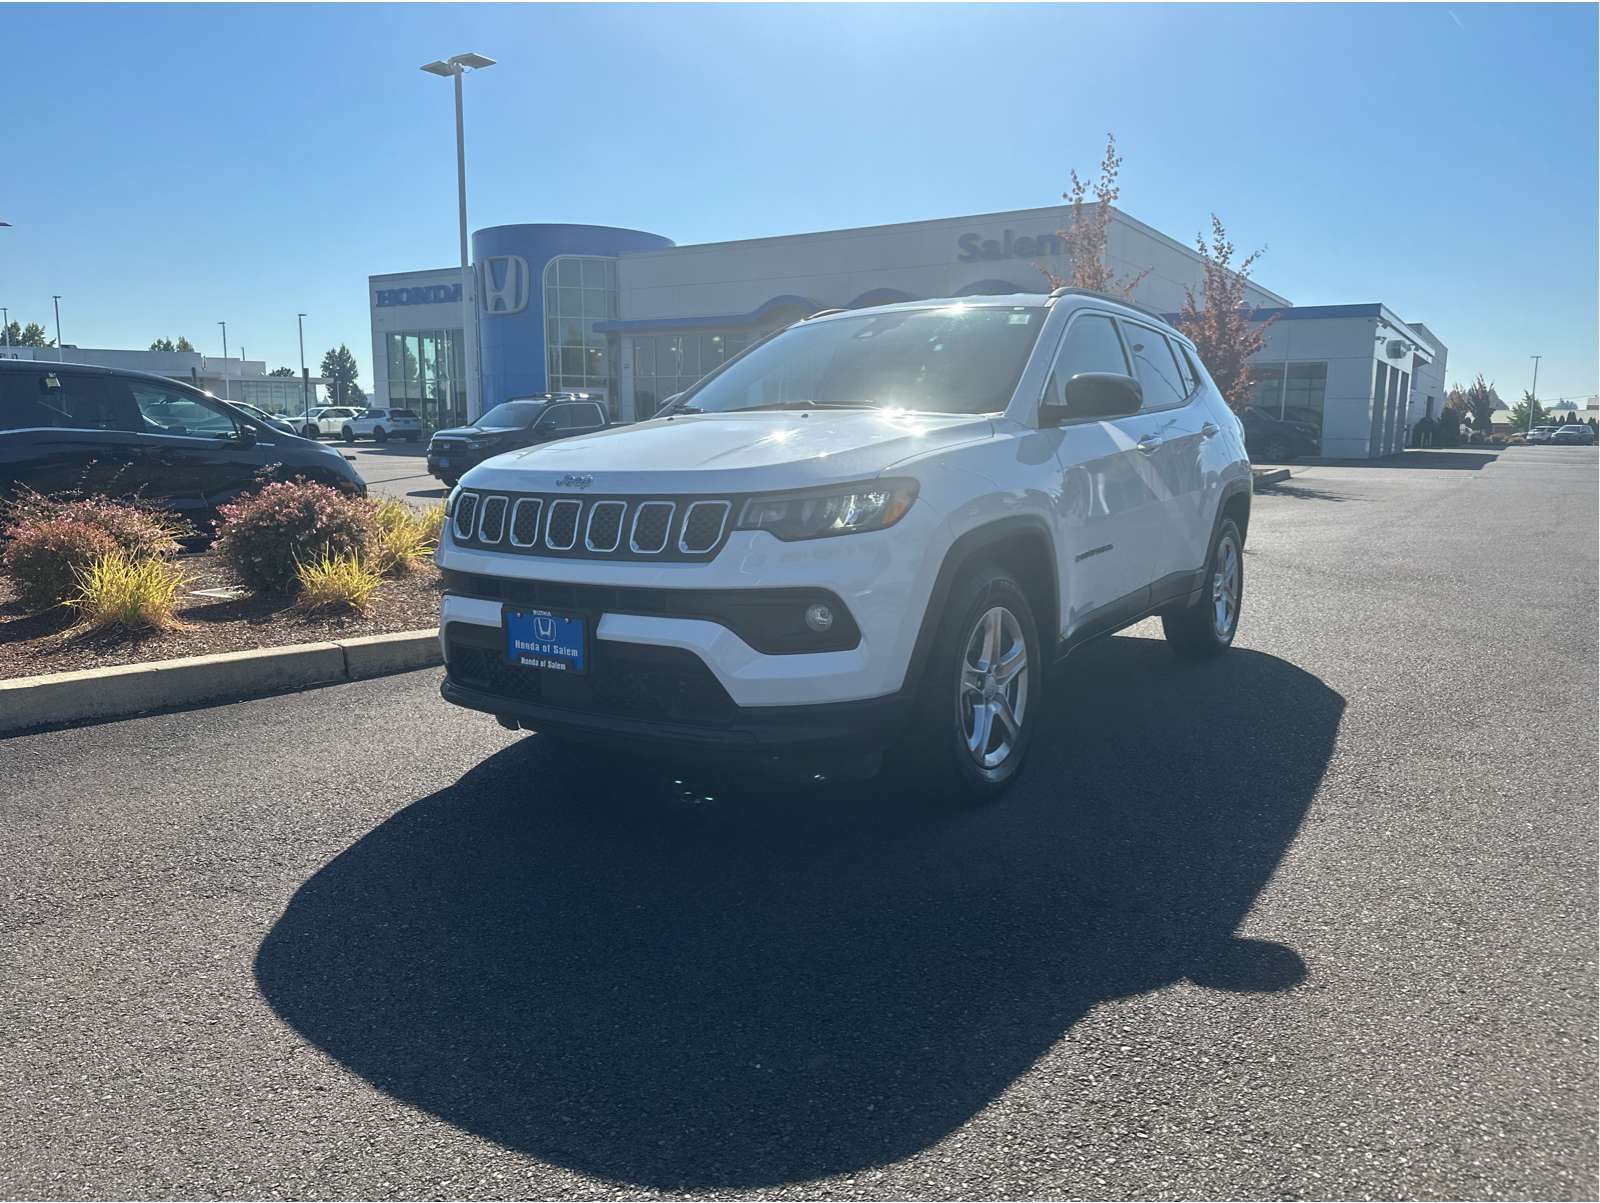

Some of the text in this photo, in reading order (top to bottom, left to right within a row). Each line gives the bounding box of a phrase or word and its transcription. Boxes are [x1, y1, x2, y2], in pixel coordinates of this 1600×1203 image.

[515, 640, 578, 657] Honda of Salem
[547, 660, 566, 671] Salem
